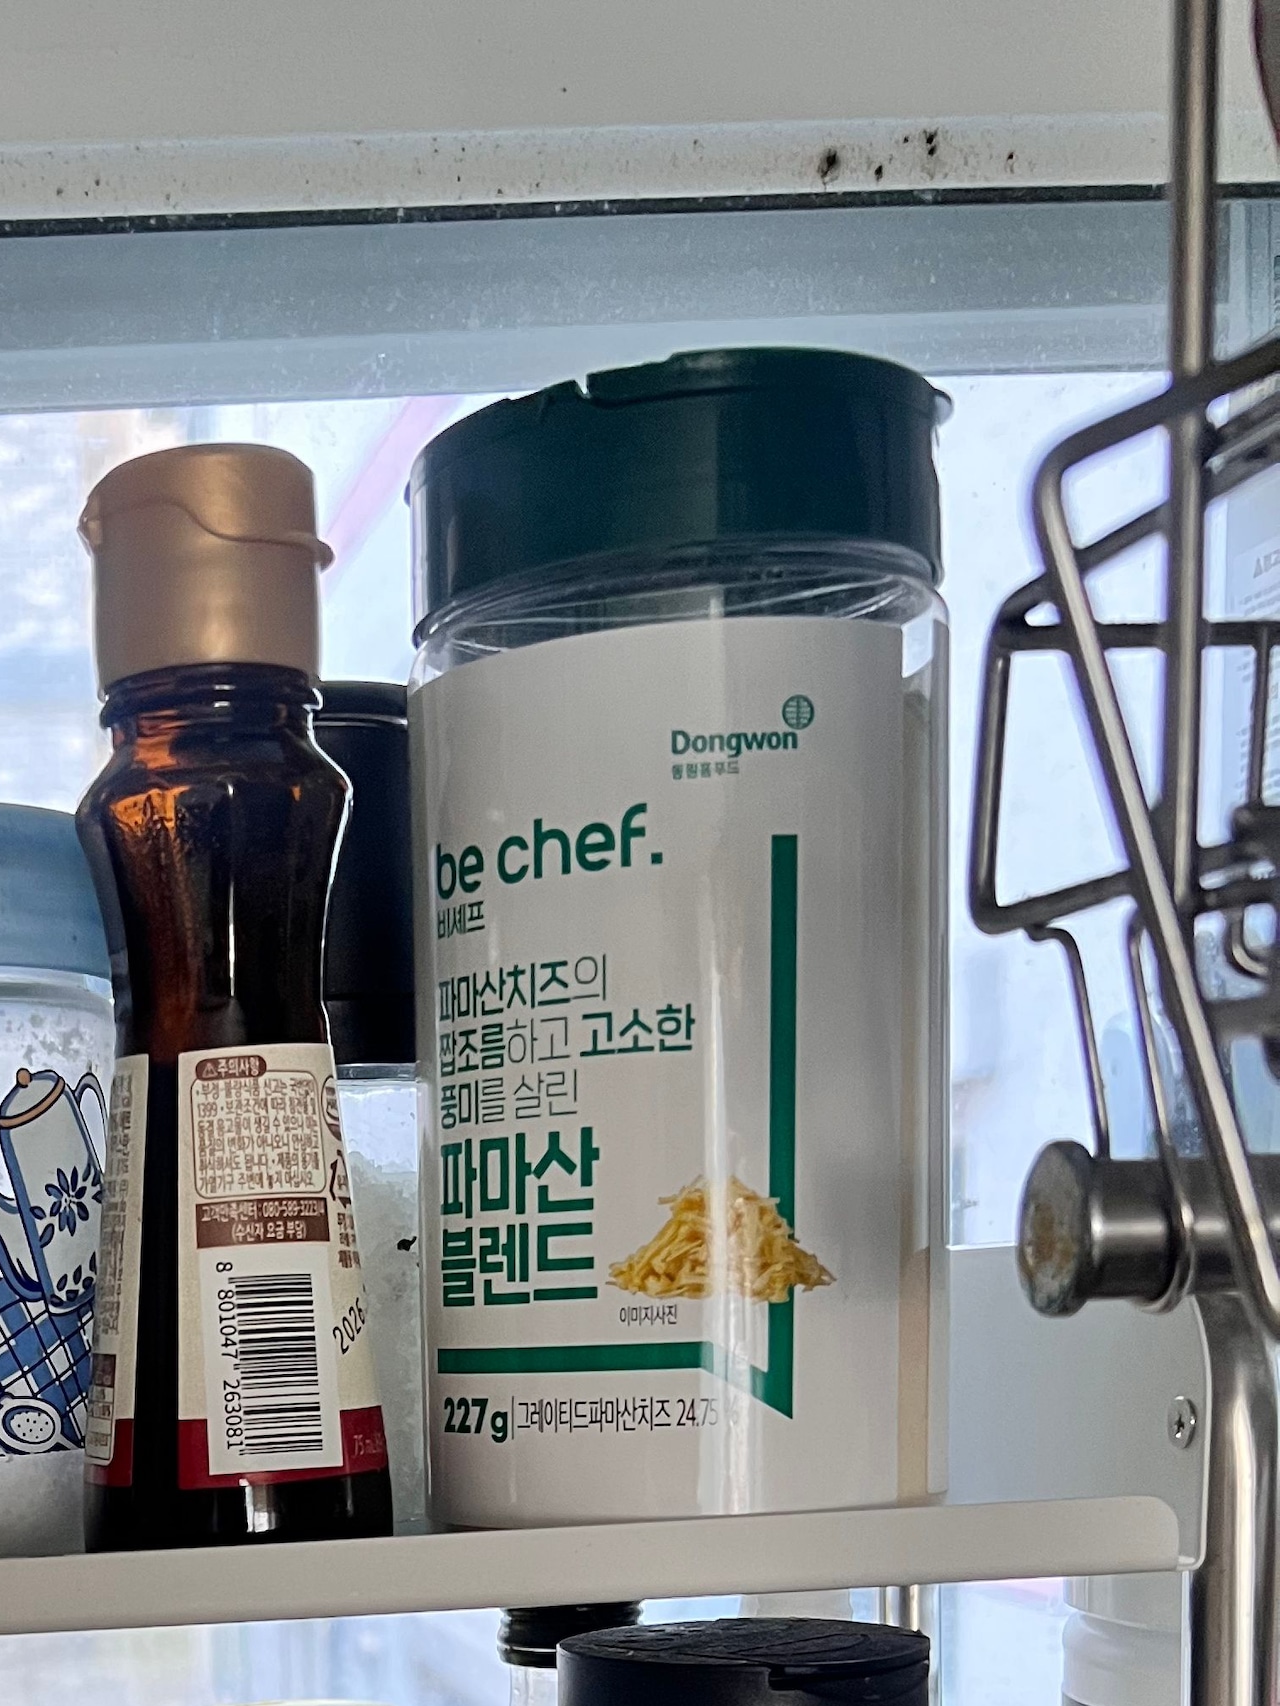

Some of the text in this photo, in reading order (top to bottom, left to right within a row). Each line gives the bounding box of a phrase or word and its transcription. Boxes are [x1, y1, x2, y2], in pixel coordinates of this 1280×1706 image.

[671, 730, 798, 758] Dongwon
[436, 802, 663, 900] be chef.
[437, 900, 485, 939] 비셰프
[439, 954, 606, 1022] 파마산치즈의
[218, 1057, 259, 1077] 주의사항
[439, 1003, 695, 1077] 짭조름하고 고소한
[441, 1068, 577, 1129] 풍미를 살린
[441, 1126, 599, 1218] 파마산
[267, 1222, 284, 1239] 요금
[442, 1222, 598, 1306] 블렌드
[620, 1304, 677, 1326] 이미지사진
[216, 1262, 243, 1449] 8 801047 263081
[517, 1397, 670, 1433] 그레이티드파마산치즈
